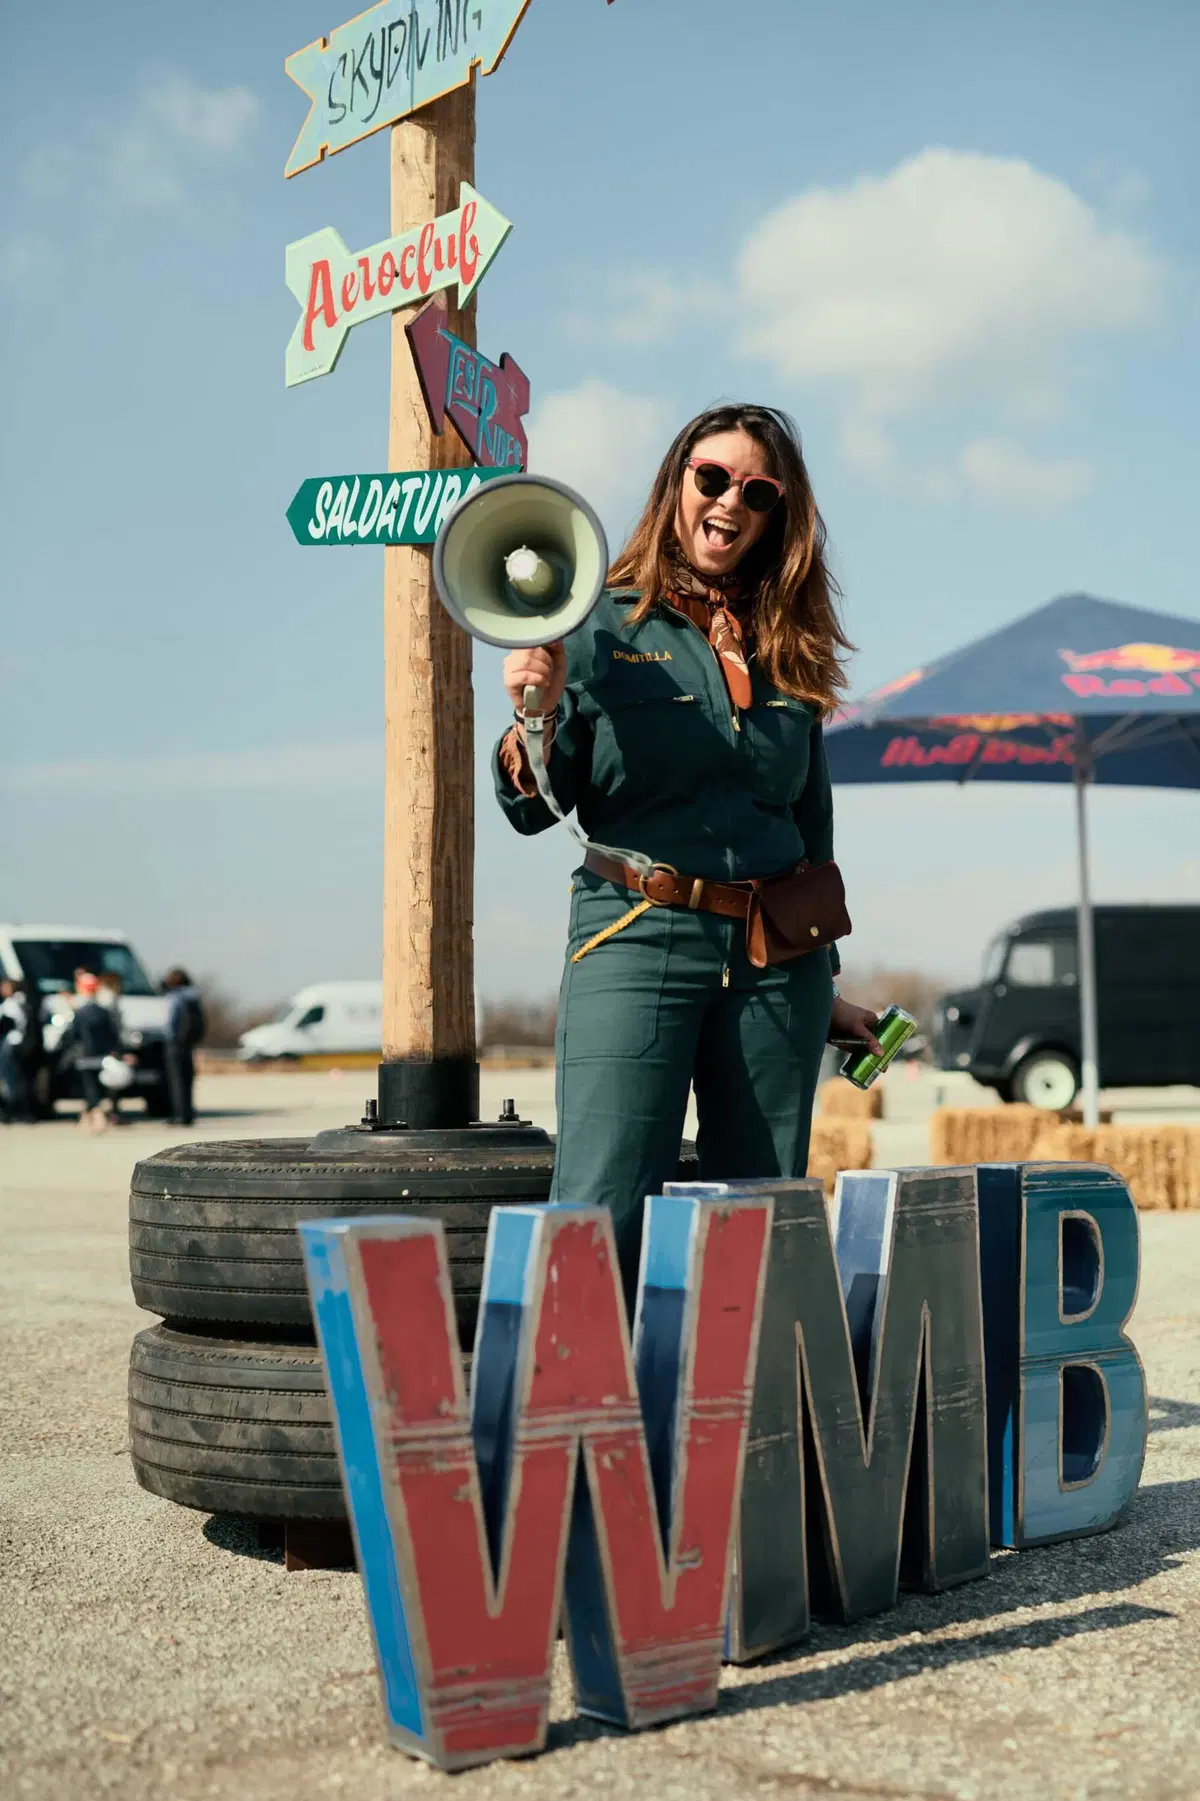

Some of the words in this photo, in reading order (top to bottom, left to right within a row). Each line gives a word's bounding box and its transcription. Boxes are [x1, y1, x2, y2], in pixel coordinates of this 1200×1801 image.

[303, 202, 483, 351] Aeroclub
[437, 328, 492, 409] TEST
[612, 650, 672, 663] DOMITILLA
[297, 1160, 1148, 1773] WMB
